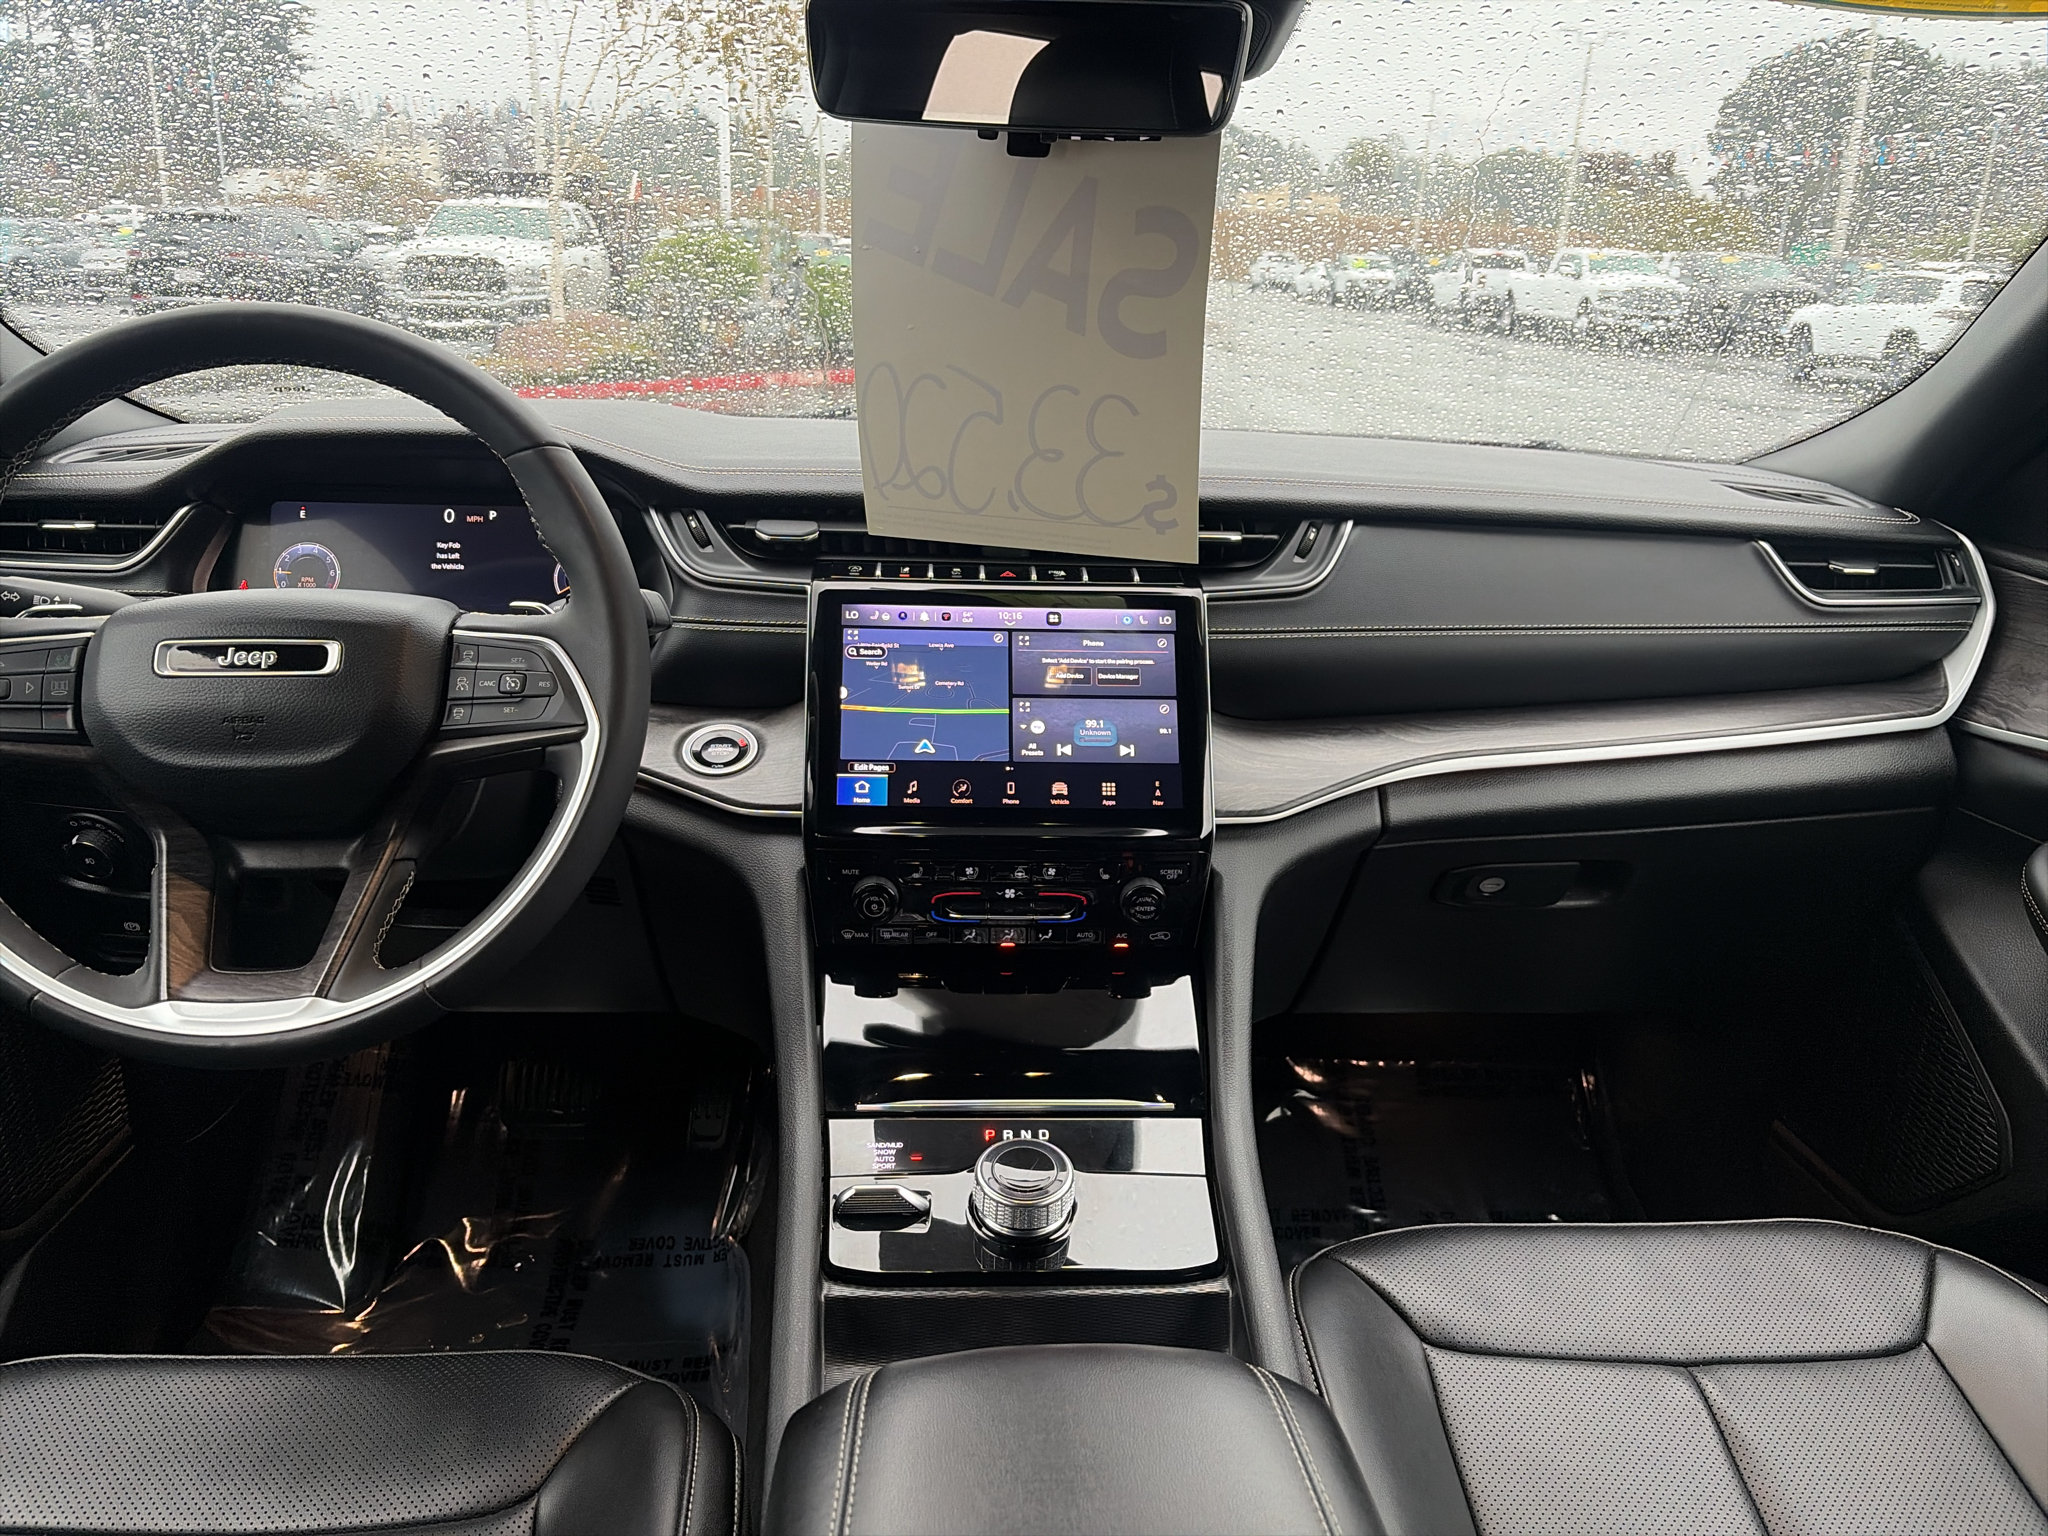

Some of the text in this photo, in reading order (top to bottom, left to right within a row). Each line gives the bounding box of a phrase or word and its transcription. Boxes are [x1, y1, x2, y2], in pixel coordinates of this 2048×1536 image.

[300, 510, 306, 519] E
[443, 508, 484, 523] 0 MPH
[488, 510, 498, 520] P
[436, 541, 461, 550] Key Fob
[845, 610, 859, 620] LO
[998, 611, 1023, 620] 10:16
[1159, 615, 1172, 625] LO
[1082, 639, 1105, 647] Phone
[859, 648, 883, 656] Search
[217, 647, 278, 669] Jeep
[1115, 673, 1139, 681] Manager
[1085, 719, 1104, 728] 99.1
[1027, 742, 1037, 750] All
[853, 763, 890, 773] Edit Pages
[950, 797, 973, 805] Comfort
[1102, 799, 1117, 807] Apps
[985, 1129, 1050, 1141] P R N D
[628, 1236, 675, 1252] COVER
[663, 1253, 705, 1269] MUST
